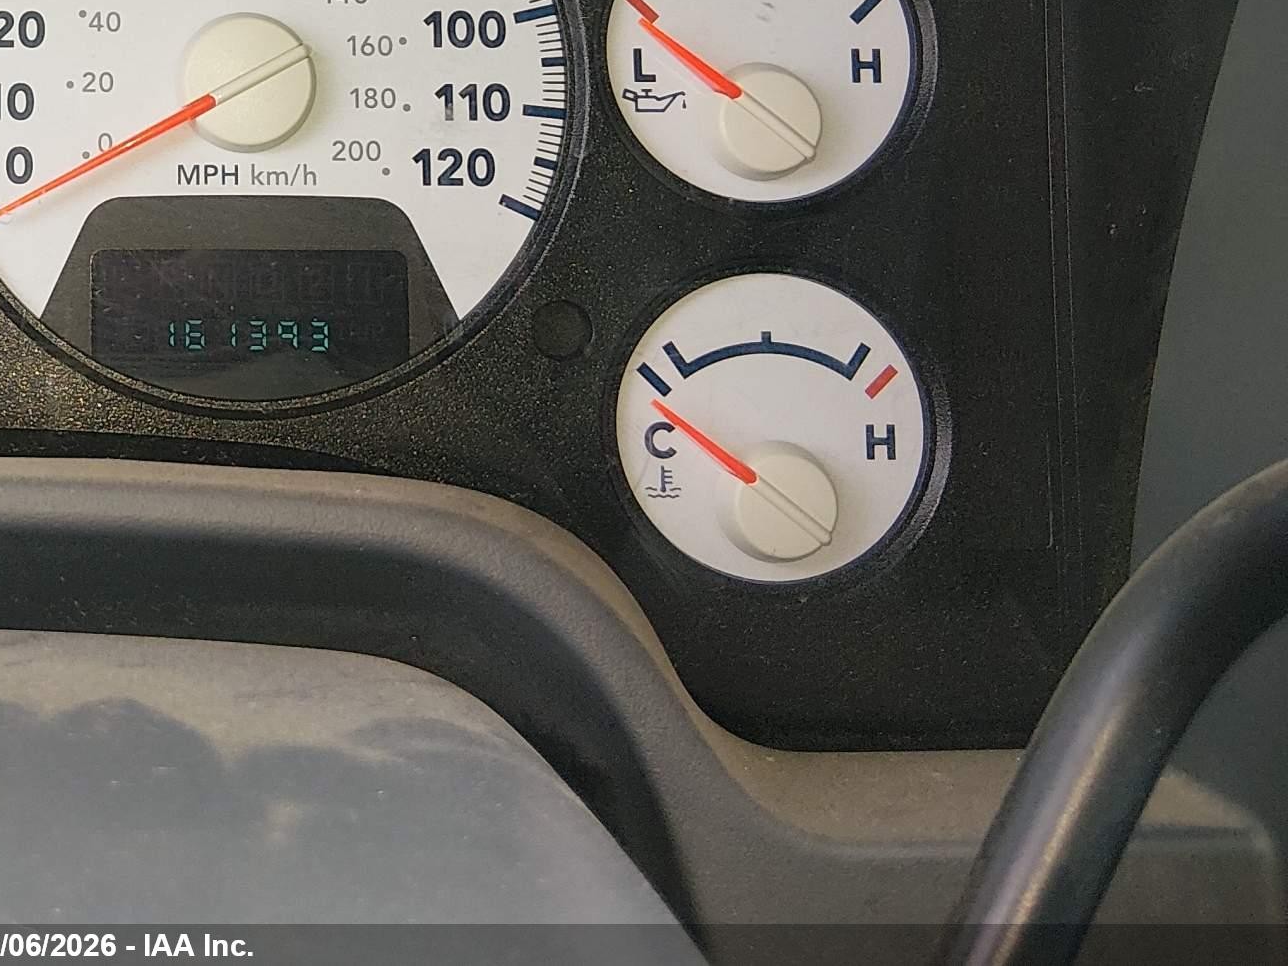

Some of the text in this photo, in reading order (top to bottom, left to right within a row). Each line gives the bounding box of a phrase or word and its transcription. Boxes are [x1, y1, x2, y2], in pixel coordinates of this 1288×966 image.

[89, 12, 120, 32] 40
[424, 11, 506, 48] 100
[347, 36, 392, 56] 160
[634, 49, 656, 82] L
[851, 49, 881, 83] H
[83, 72, 113, 92] 20
[350, 88, 395, 108] 180
[435, 83, 510, 121] 110
[98, 133, 113, 153] 0
[333, 141, 380, 161] 200
[6, 147, 33, 184] 0
[178, 164, 316, 186] MPH km/h
[412, 148, 495, 186] 120
[170, 320, 328, 351] 161393
[644, 422, 677, 459] C
[866, 425, 896, 460] H
